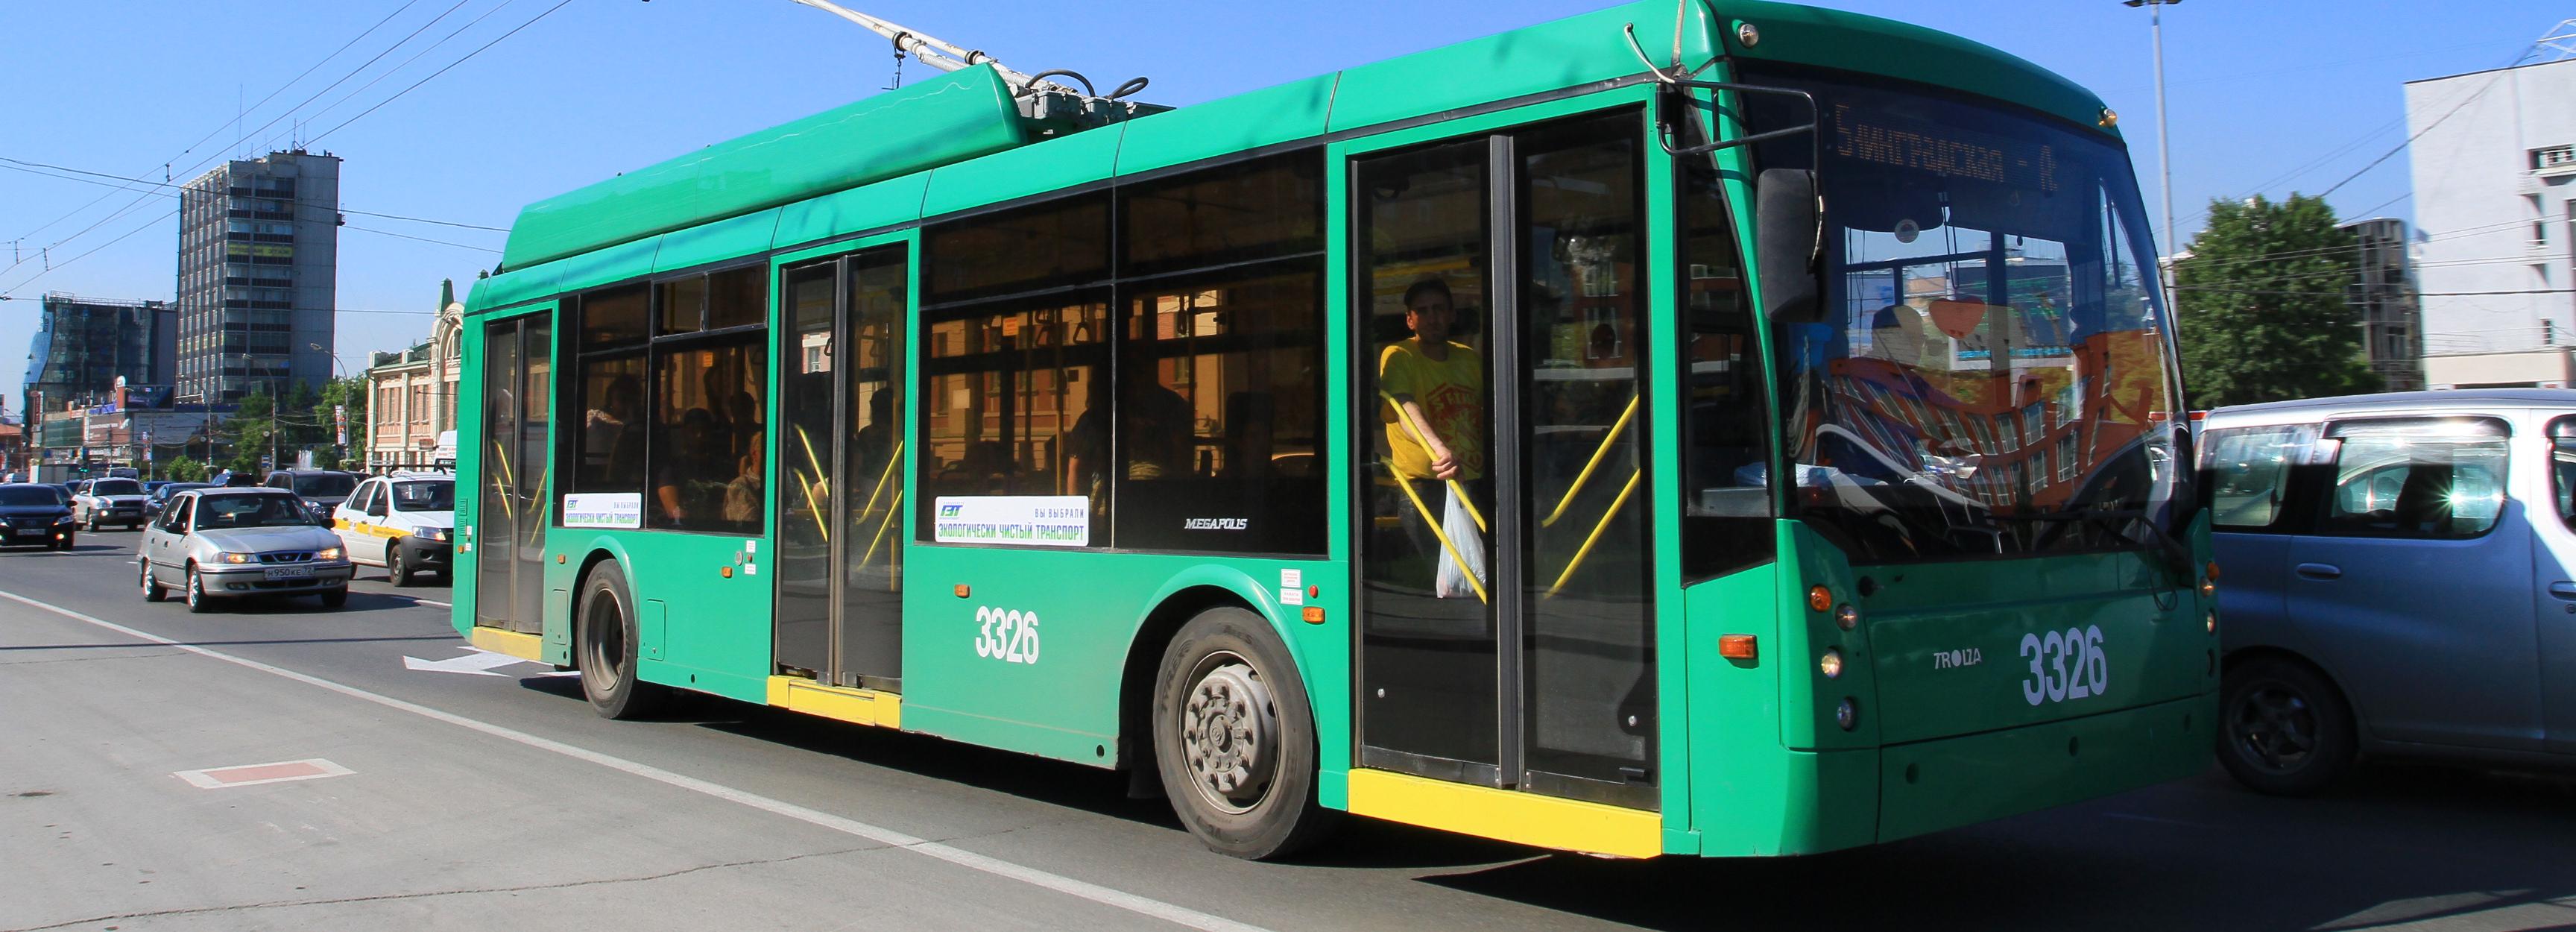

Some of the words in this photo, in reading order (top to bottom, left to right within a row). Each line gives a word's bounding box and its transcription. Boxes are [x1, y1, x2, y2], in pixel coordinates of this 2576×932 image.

[1035, 508, 1045, 518] ВЫ
[1048, 508, 1085, 519] ВЫБРАЛИ
[938, 523, 996, 538] ЭКОЛОГИЧЕСКИ
[1000, 522, 1032, 539] ЧИСТЫЙ
[1036, 524, 1084, 541] ТРАНСПОРТ
[1184, 518, 1248, 530] MEGAPOLIS
[976, 605, 1038, 664] 3326
[1933, 648, 1982, 670] TROLZA
[2020, 625, 2108, 706] 3326
